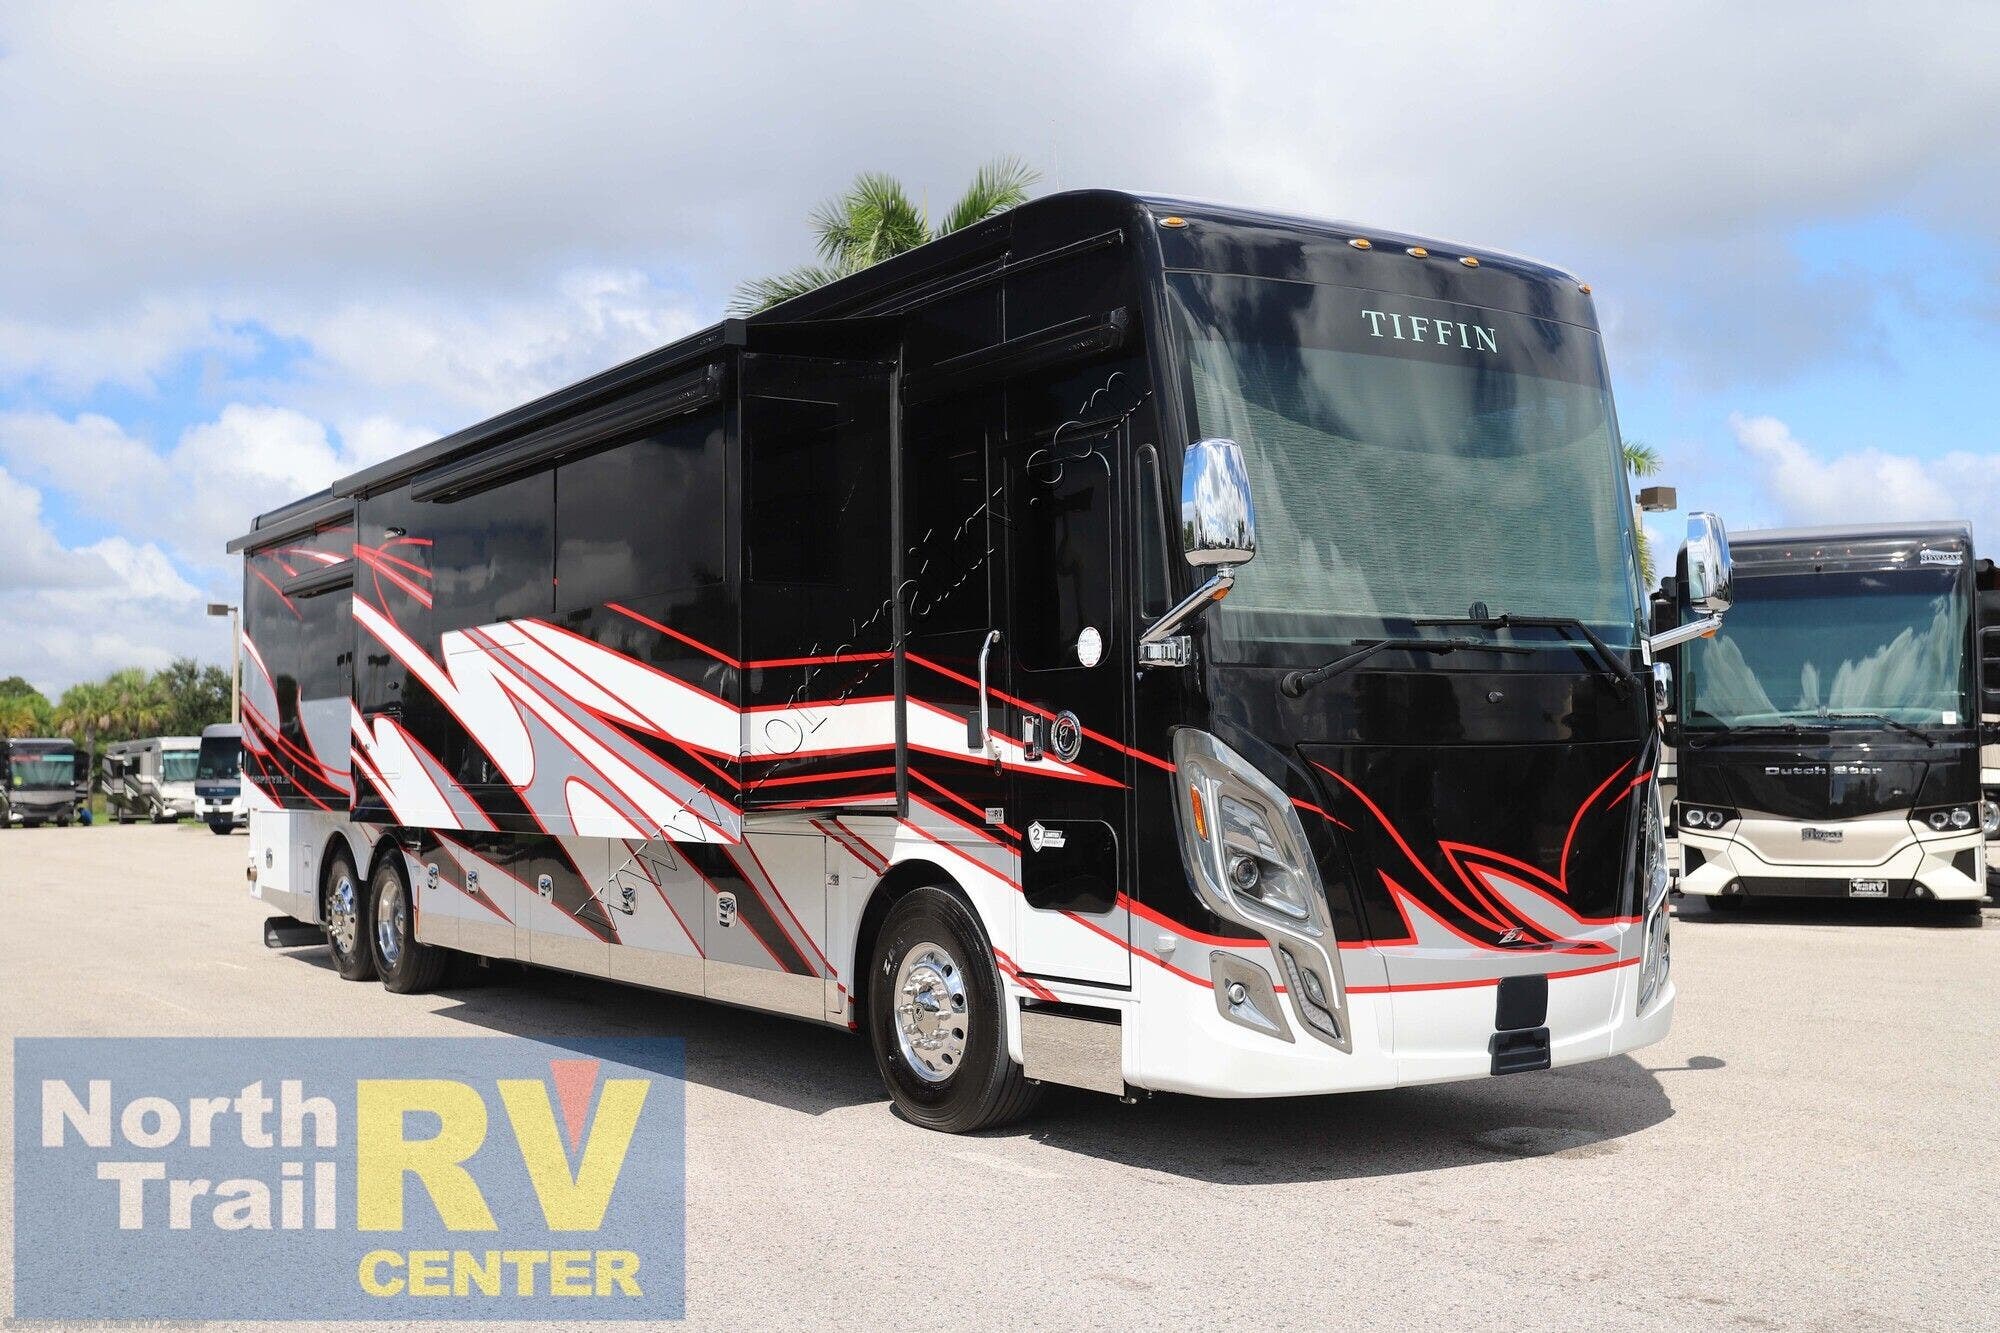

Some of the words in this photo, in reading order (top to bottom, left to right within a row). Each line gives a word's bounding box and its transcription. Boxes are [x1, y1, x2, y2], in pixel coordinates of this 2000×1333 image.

[1361, 309, 1498, 354] TIFFIN
[1765, 766, 1827, 775] Dutch
[1833, 765, 1882, 775] Star
[1033, 828, 1040, 841] 2
